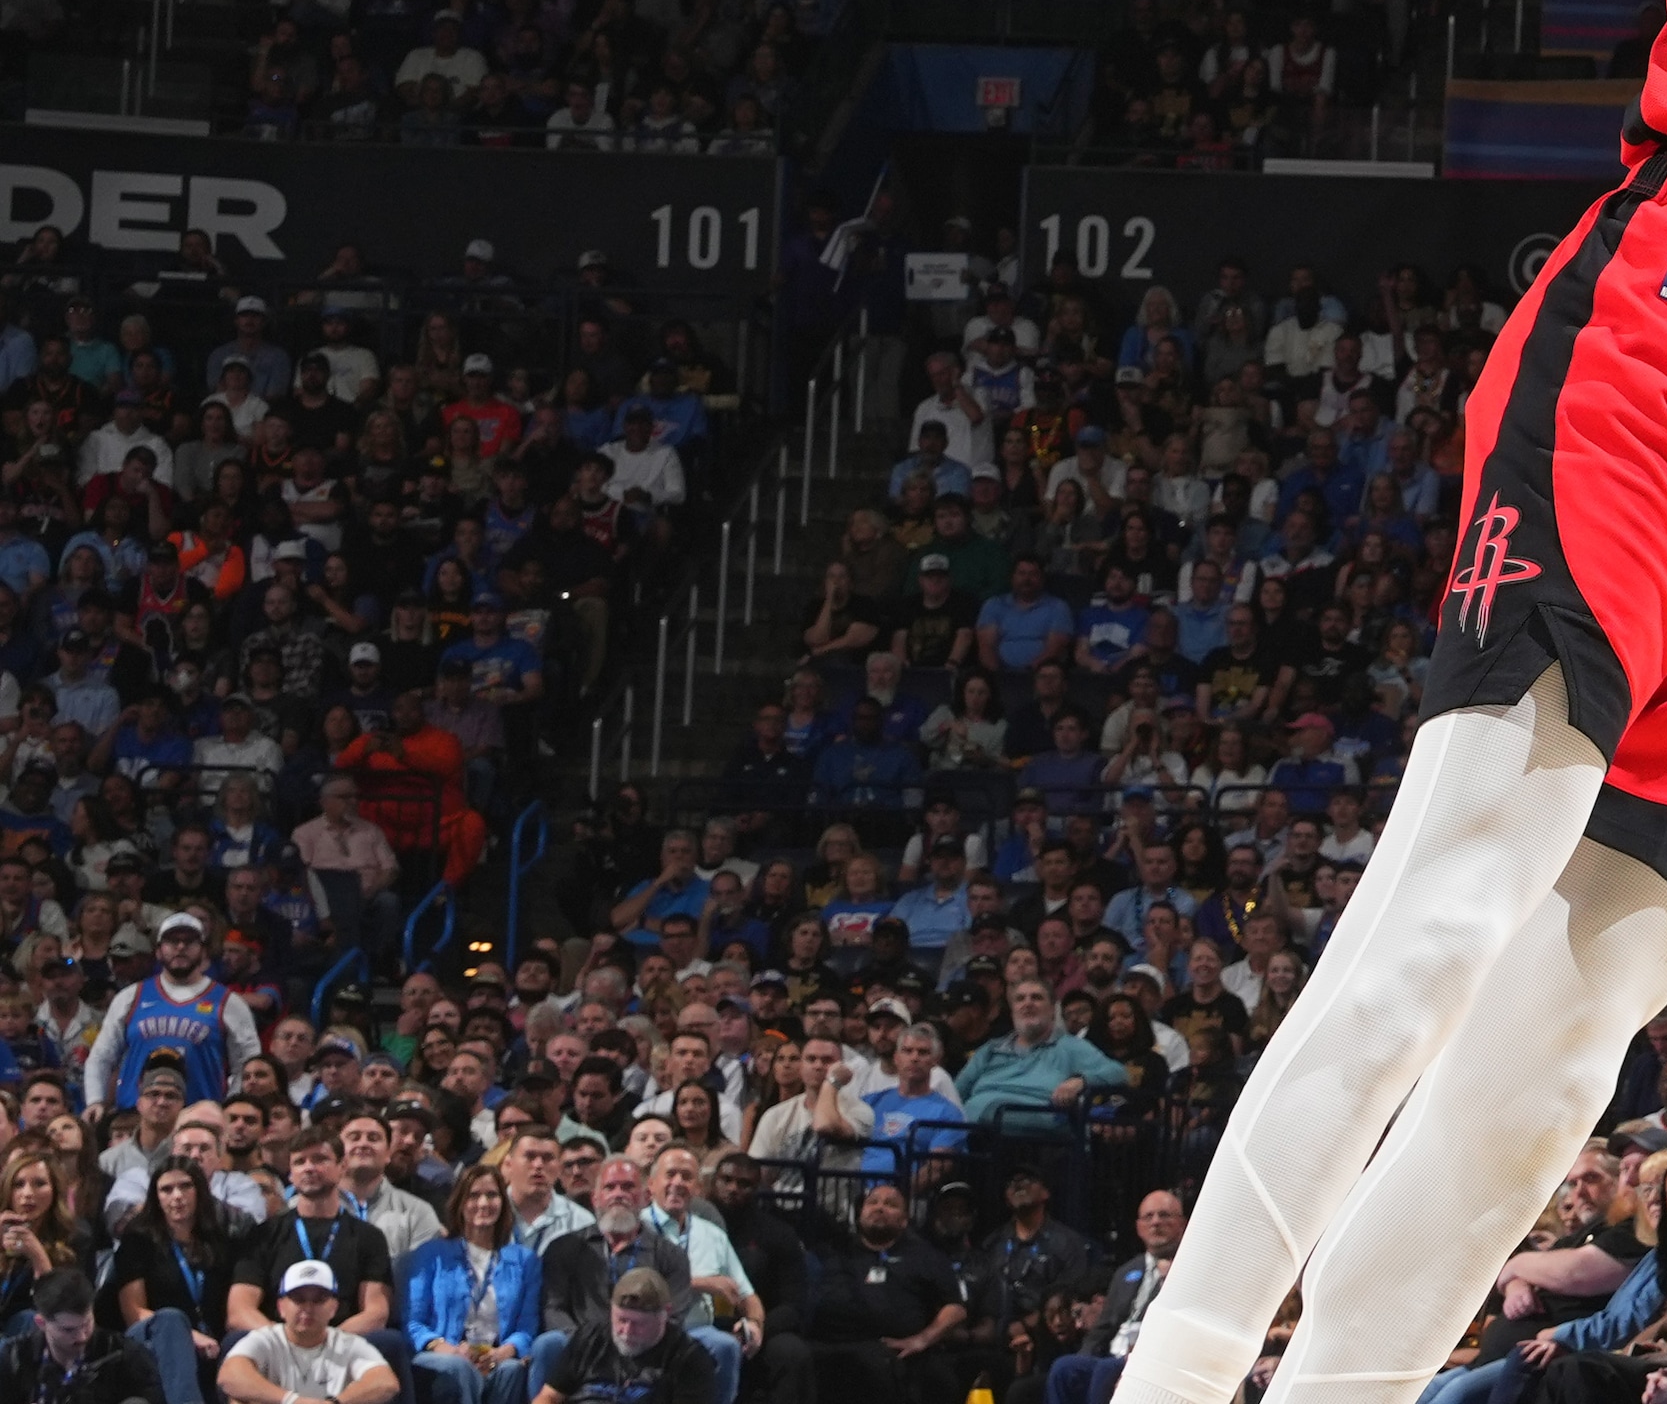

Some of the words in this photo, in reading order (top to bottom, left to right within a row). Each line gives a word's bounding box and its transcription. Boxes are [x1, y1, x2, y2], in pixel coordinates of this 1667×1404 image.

[650, 202, 761, 271] 101
[1039, 212, 1157, 280] 102
[137, 1016, 210, 1046] THUNDER
